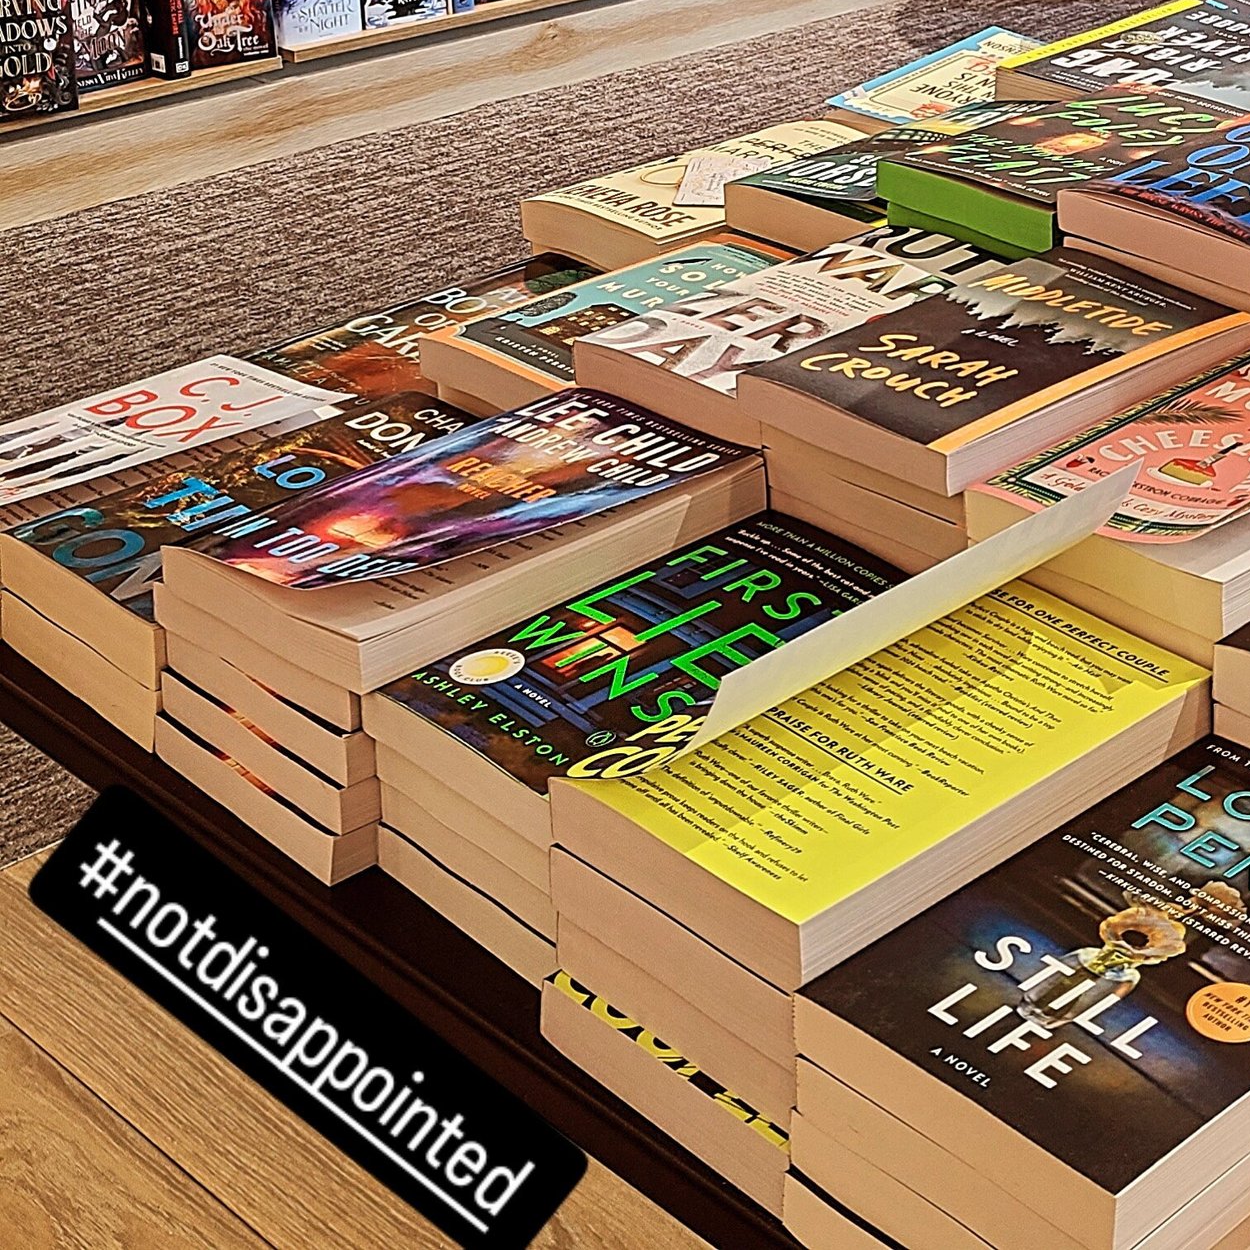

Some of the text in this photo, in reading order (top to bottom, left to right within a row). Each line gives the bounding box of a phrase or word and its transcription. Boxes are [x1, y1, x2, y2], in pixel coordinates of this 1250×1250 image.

[968, 273, 1173, 339] MIDDLETIDE
[799, 352, 978, 409] CROUCH
[859, 333, 1019, 387] SARAH
[84, 389, 230, 444] BOX
[493, 417, 669, 487] ANDREW CHILD
[514, 397, 721, 473] LEE CHILD
[568, 570, 787, 690] LIE
[507, 614, 697, 725] WINS
[411, 671, 569, 768] ASHLEY ELSTON
[974, 936, 1158, 1060] STILL
[927, 983, 1091, 1089] LIFE
[945, 1051, 991, 1089] NOVEL
